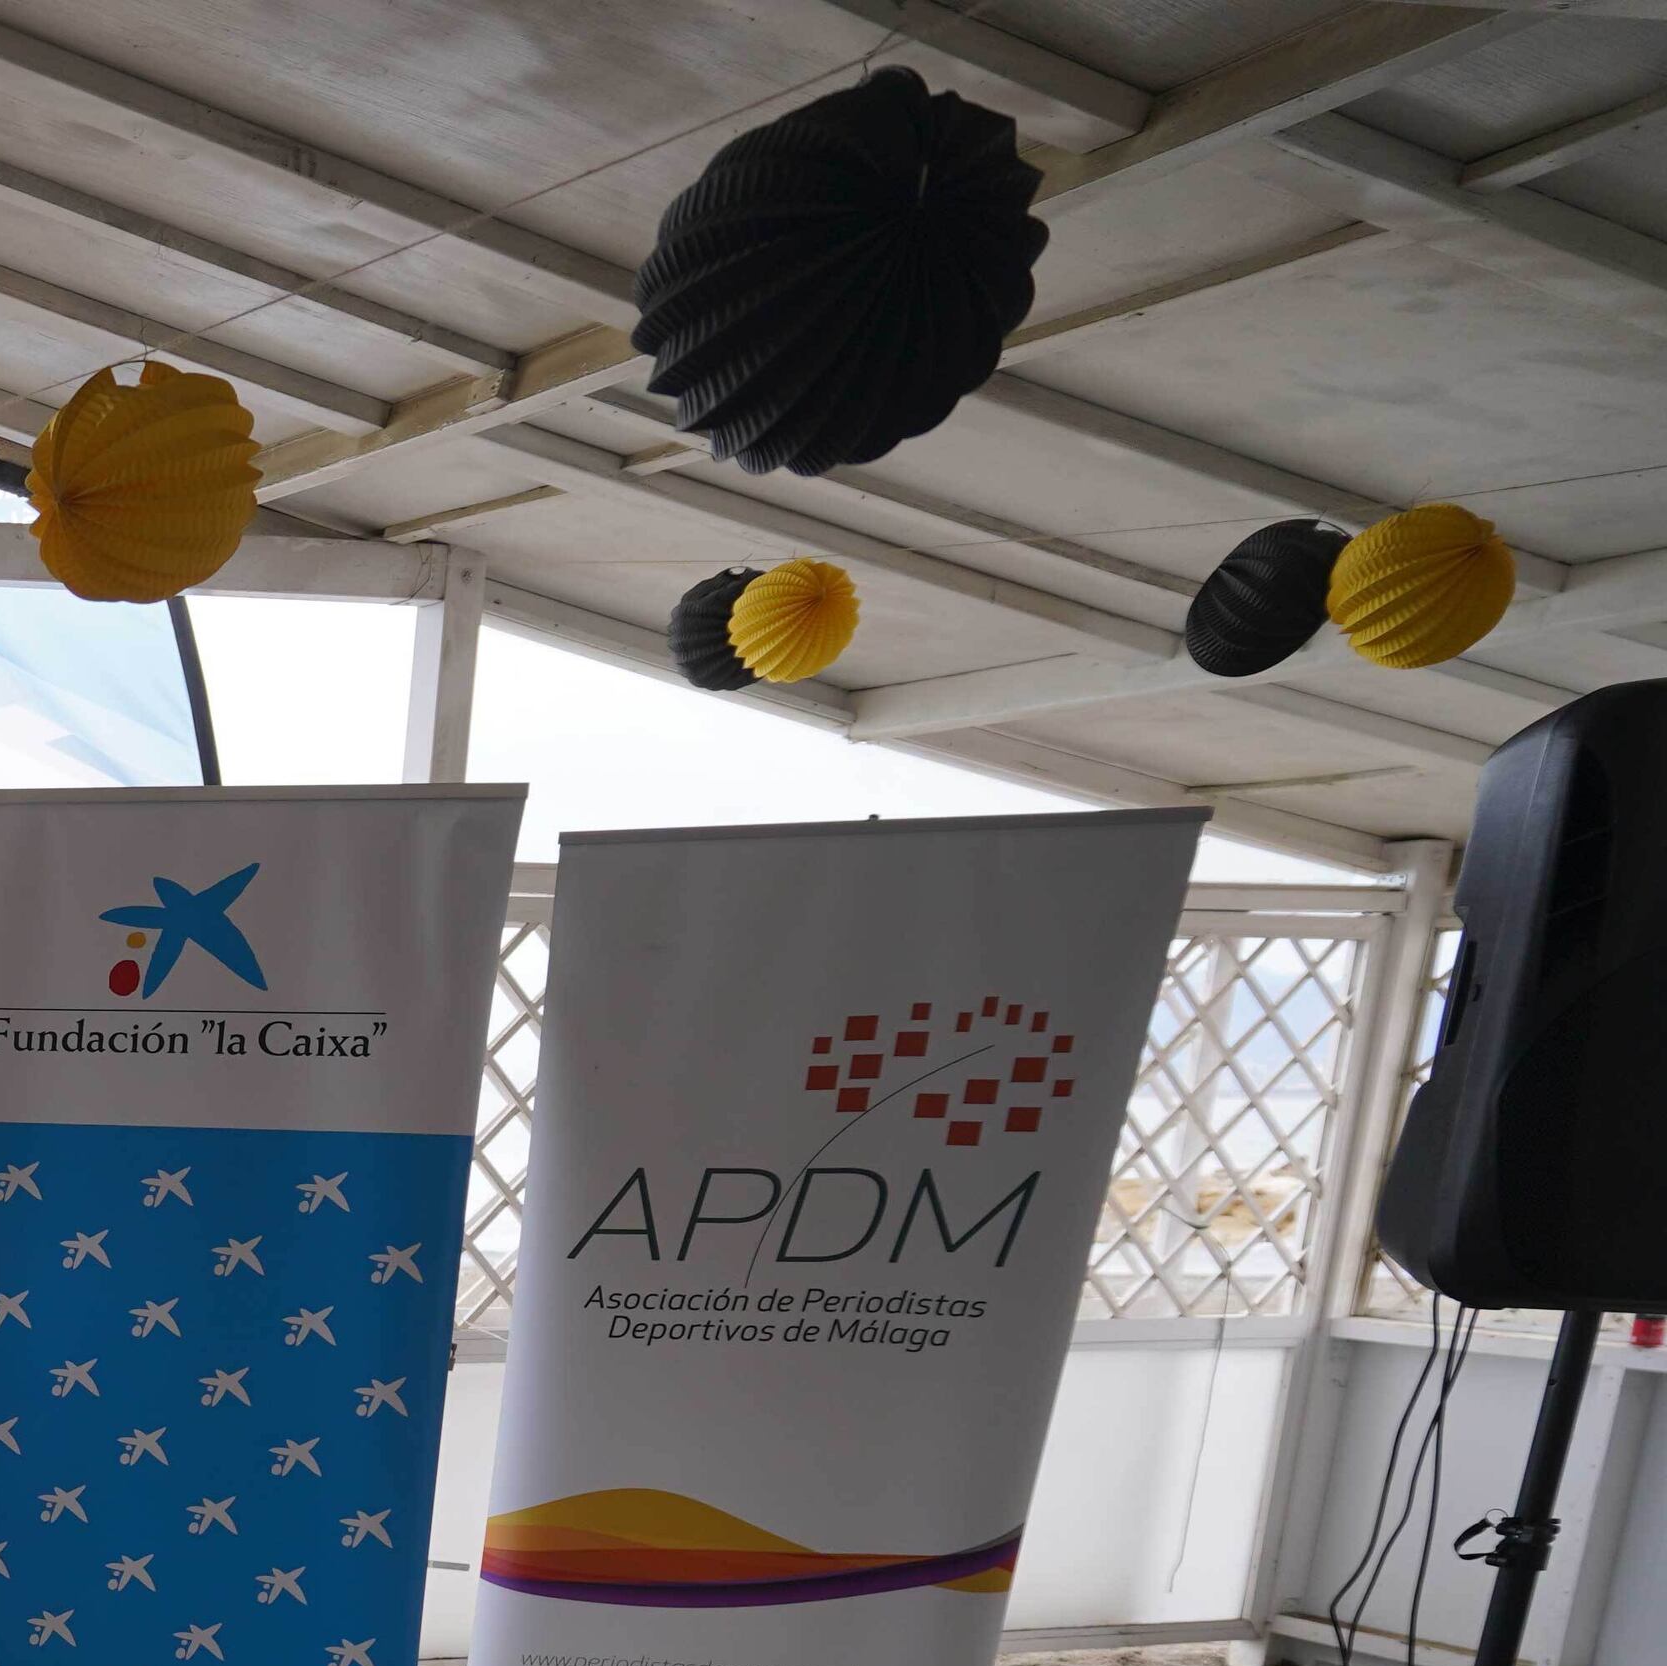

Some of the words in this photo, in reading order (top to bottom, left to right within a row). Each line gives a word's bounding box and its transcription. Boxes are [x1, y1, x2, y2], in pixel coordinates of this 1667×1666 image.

[567, 1166, 1042, 1269] APDM
[585, 1284, 750, 1315] Asociación
[757, 1288, 794, 1313] de
[801, 1288, 987, 1320] Periodistas
[608, 1314, 774, 1347] Deportivos
[781, 1317, 820, 1344] de
[827, 1317, 951, 1353] Málaga
